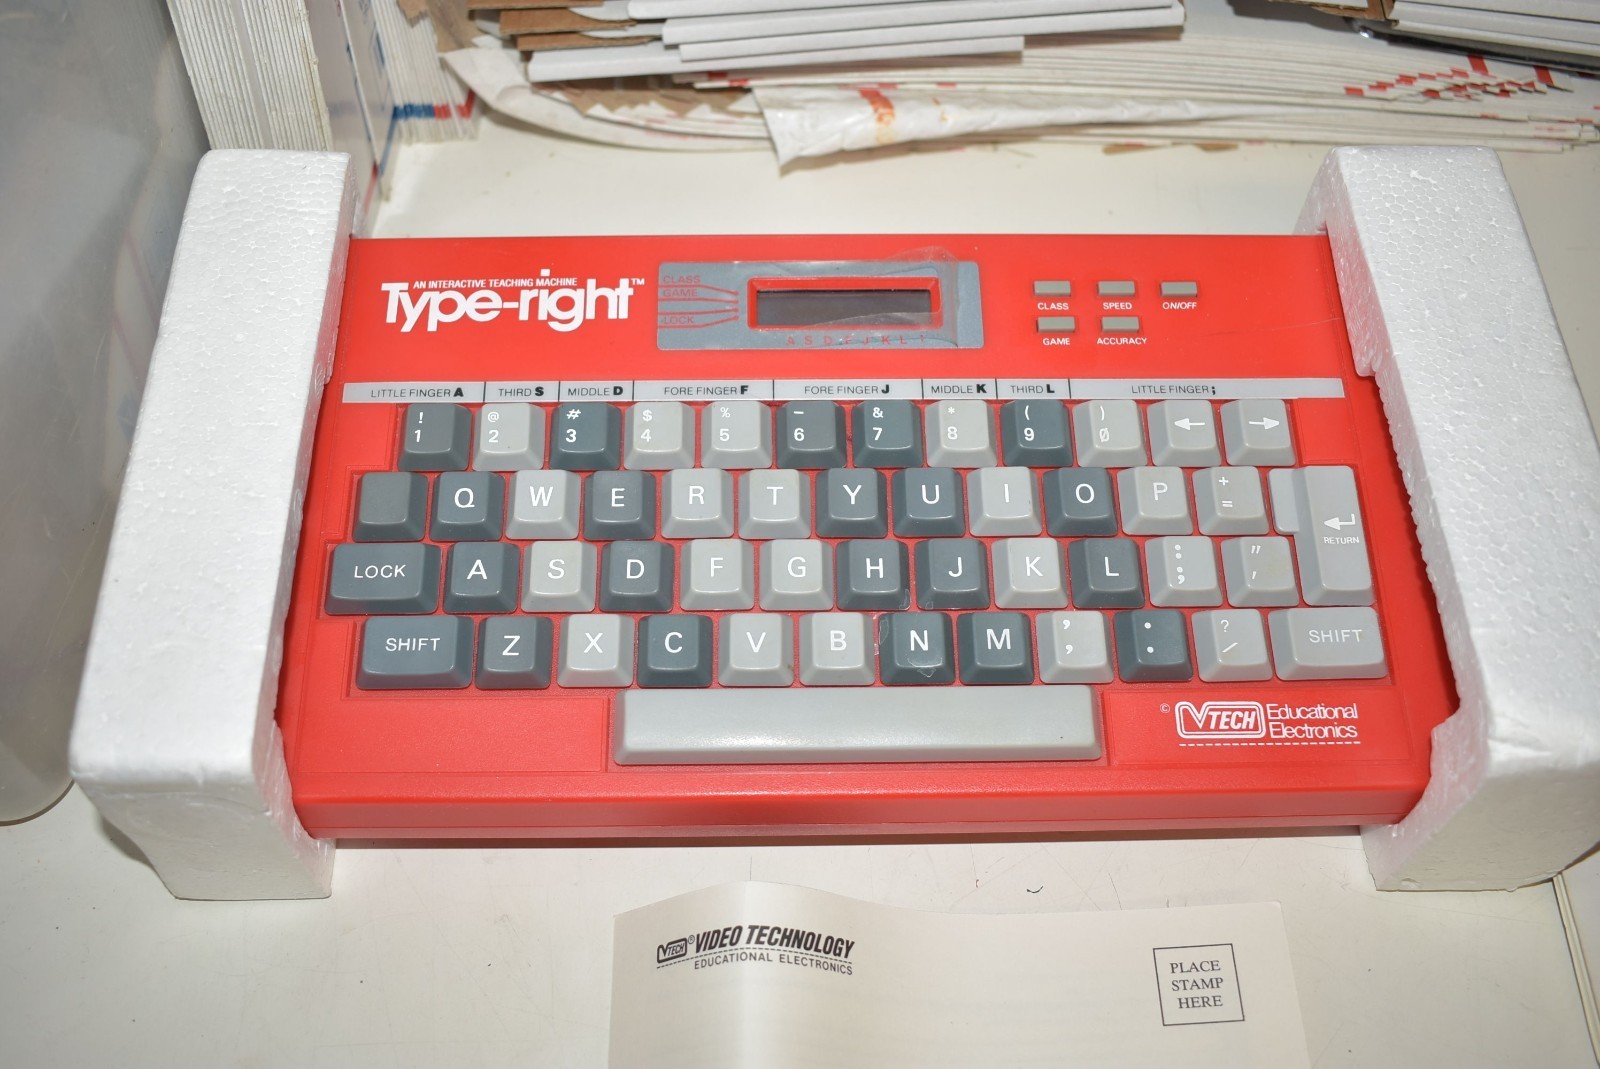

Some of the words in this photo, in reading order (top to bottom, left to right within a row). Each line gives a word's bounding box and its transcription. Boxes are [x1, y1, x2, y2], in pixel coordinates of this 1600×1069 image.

[413, 280, 426, 289] AN
[428, 279, 486, 288] INTERACTIVE
[489, 279, 534, 287] TEACHING
[536, 278, 577, 287] MACHINE
[663, 275, 700, 283] CLASS
[381, 269, 634, 332] Type-right
[1037, 302, 1069, 310] CLASS
[1103, 302, 1132, 310] SPEED
[664, 316, 694, 324] LOCK
[805, 336, 813, 345] S
[824, 336, 833, 345] D
[882, 336, 890, 344] K
[900, 336, 907, 344] L
[1097, 337, 1147, 345] ACCURACY
[371, 388, 406, 397] LITTLE
[409, 388, 451, 397] FINGER
[453, 388, 463, 397] A
[499, 388, 532, 397] THIRD
[535, 387, 544, 396] S
[568, 387, 610, 396] MIDDLE
[613, 386, 623, 396] D
[664, 387, 693, 395] FORE
[696, 386, 737, 395] FINGER
[741, 385, 749, 394] F
[805, 385, 833, 394] FORE
[837, 385, 878, 394] FINGER
[882, 384, 889, 394] J
[931, 385, 973, 393] MIDDLE
[976, 384, 986, 393] K
[1010, 386, 1043, 394] THIRD
[1047, 384, 1055, 394] L
[1132, 385, 1166, 394] LITTLE
[1169, 385, 1209, 394] FINGER
[1211, 386, 1216, 396] ;
[418, 411, 423, 423] !
[488, 411, 499, 422] @
[567, 409, 581, 420] #
[642, 409, 652, 422] $
[720, 407, 731, 418] %
[872, 407, 883, 418] &
[1024, 406, 1029, 420] (
[1100, 406, 1105, 420] )
[414, 430, 421, 442] 1
[488, 431, 499, 442] 2
[566, 429, 577, 442] 3
[641, 429, 651, 442] 4
[719, 429, 729, 441] 5
[793, 428, 804, 441] 6
[872, 428, 883, 440] 7
[948, 427, 958, 439] 8
[1024, 428, 1034, 441] 9
[454, 488, 474, 508] Q
[529, 487, 553, 506] W
[611, 488, 624, 507] E
[689, 486, 704, 505] R
[767, 487, 783, 505] T
[843, 486, 862, 504] Y
[922, 485, 939, 504] U
[1075, 483, 1094, 503] O
[1154, 483, 1168, 500] P
[1324, 537, 1359, 545] RETURN
[354, 565, 406, 578] LOCK
[467, 560, 487, 580] A
[548, 559, 565, 579] S
[626, 560, 644, 579] D
[710, 558, 723, 577] F
[788, 557, 806, 578] G
[866, 558, 883, 578] H
[949, 557, 962, 577] J
[1026, 557, 1043, 576] K
[1106, 557, 1119, 576] L
[1221, 620, 1229, 632] ?
[584, 632, 603, 652] X
[664, 632, 682, 652] C
[746, 632, 766, 652] V
[830, 630, 846, 650] B
[910, 630, 928, 651] N
[987, 629, 1010, 649] M
[1308, 630, 1362, 642] SHIFT
[385, 638, 440, 652] SHIFT
[502, 636, 519, 655] Z
[1266, 703, 1358, 719] Educational
[1269, 722, 1358, 738] Electronics
[695, 925, 743, 953] VIDEO
[745, 925, 855, 959] TECHNOLOGY
[694, 952, 773, 970] EDUCATIONAL
[779, 954, 853, 975] ELECTRONICS
[1170, 960, 1221, 973] PLACE
[1171, 977, 1223, 991] STAMP
[1178, 996, 1223, 1008] HERE
